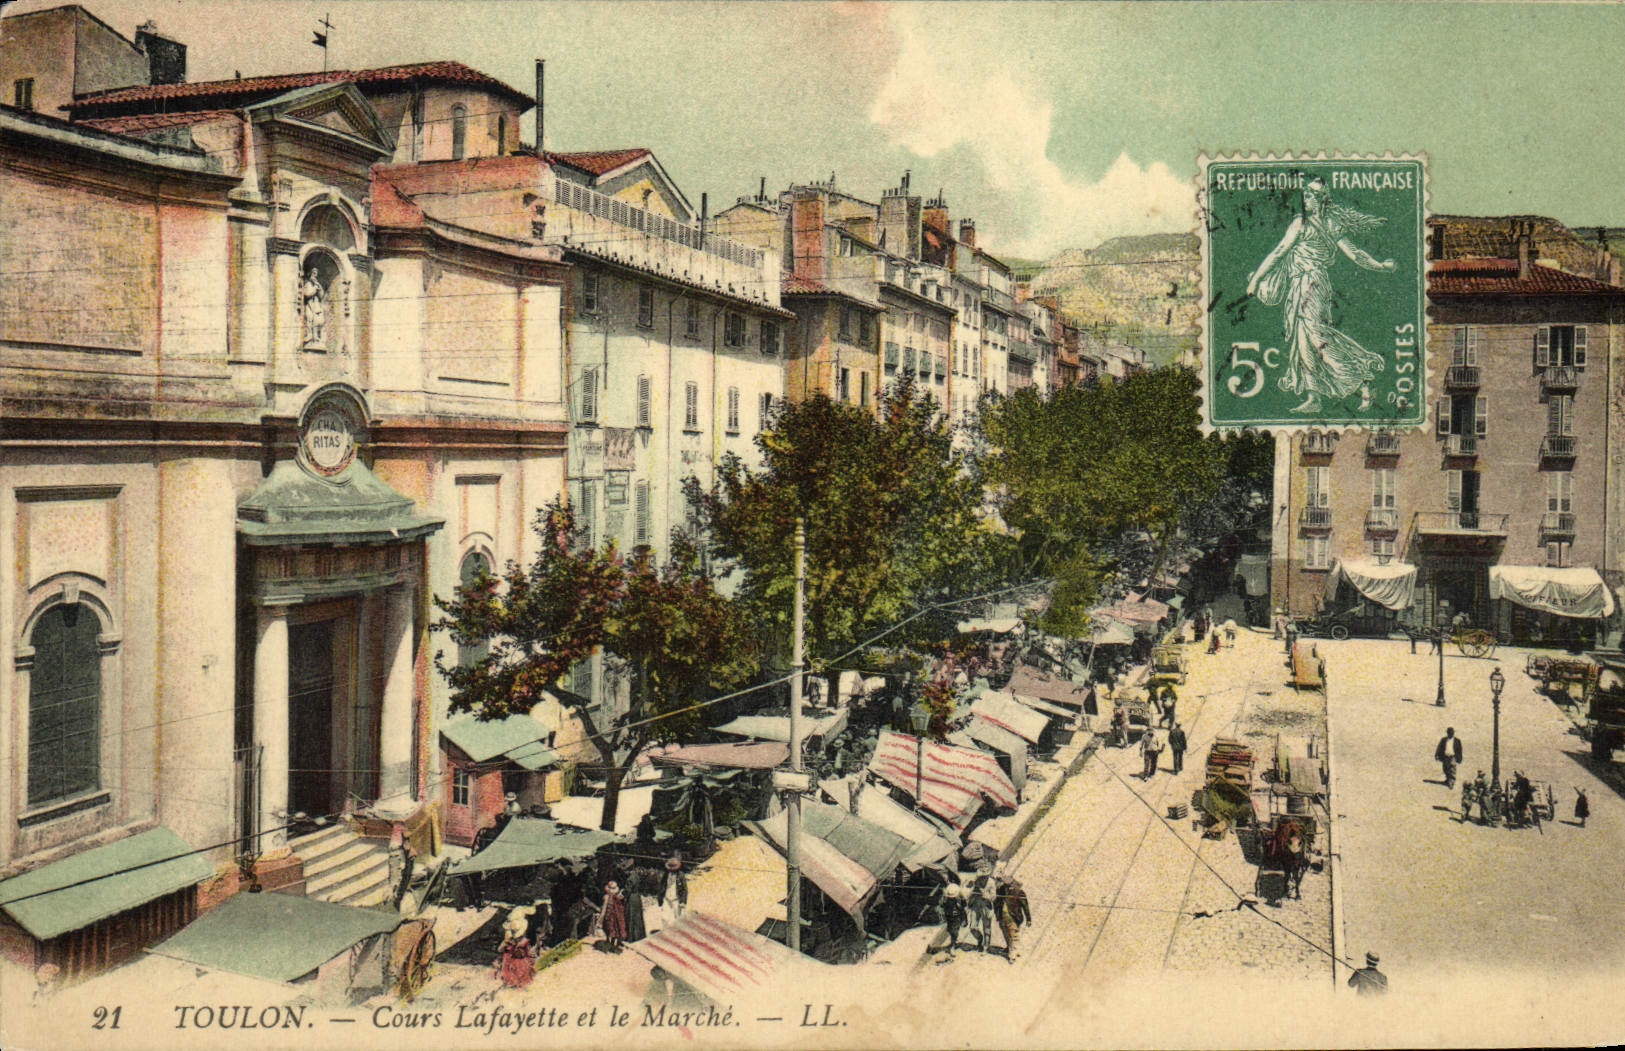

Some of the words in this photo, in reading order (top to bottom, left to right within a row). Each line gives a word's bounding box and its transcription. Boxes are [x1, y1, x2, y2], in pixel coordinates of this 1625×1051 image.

[1331, 171, 1413, 192] FRANÇAISE
[1395, 323, 1415, 409] POSTES
[313, 435, 341, 449] RITAS
